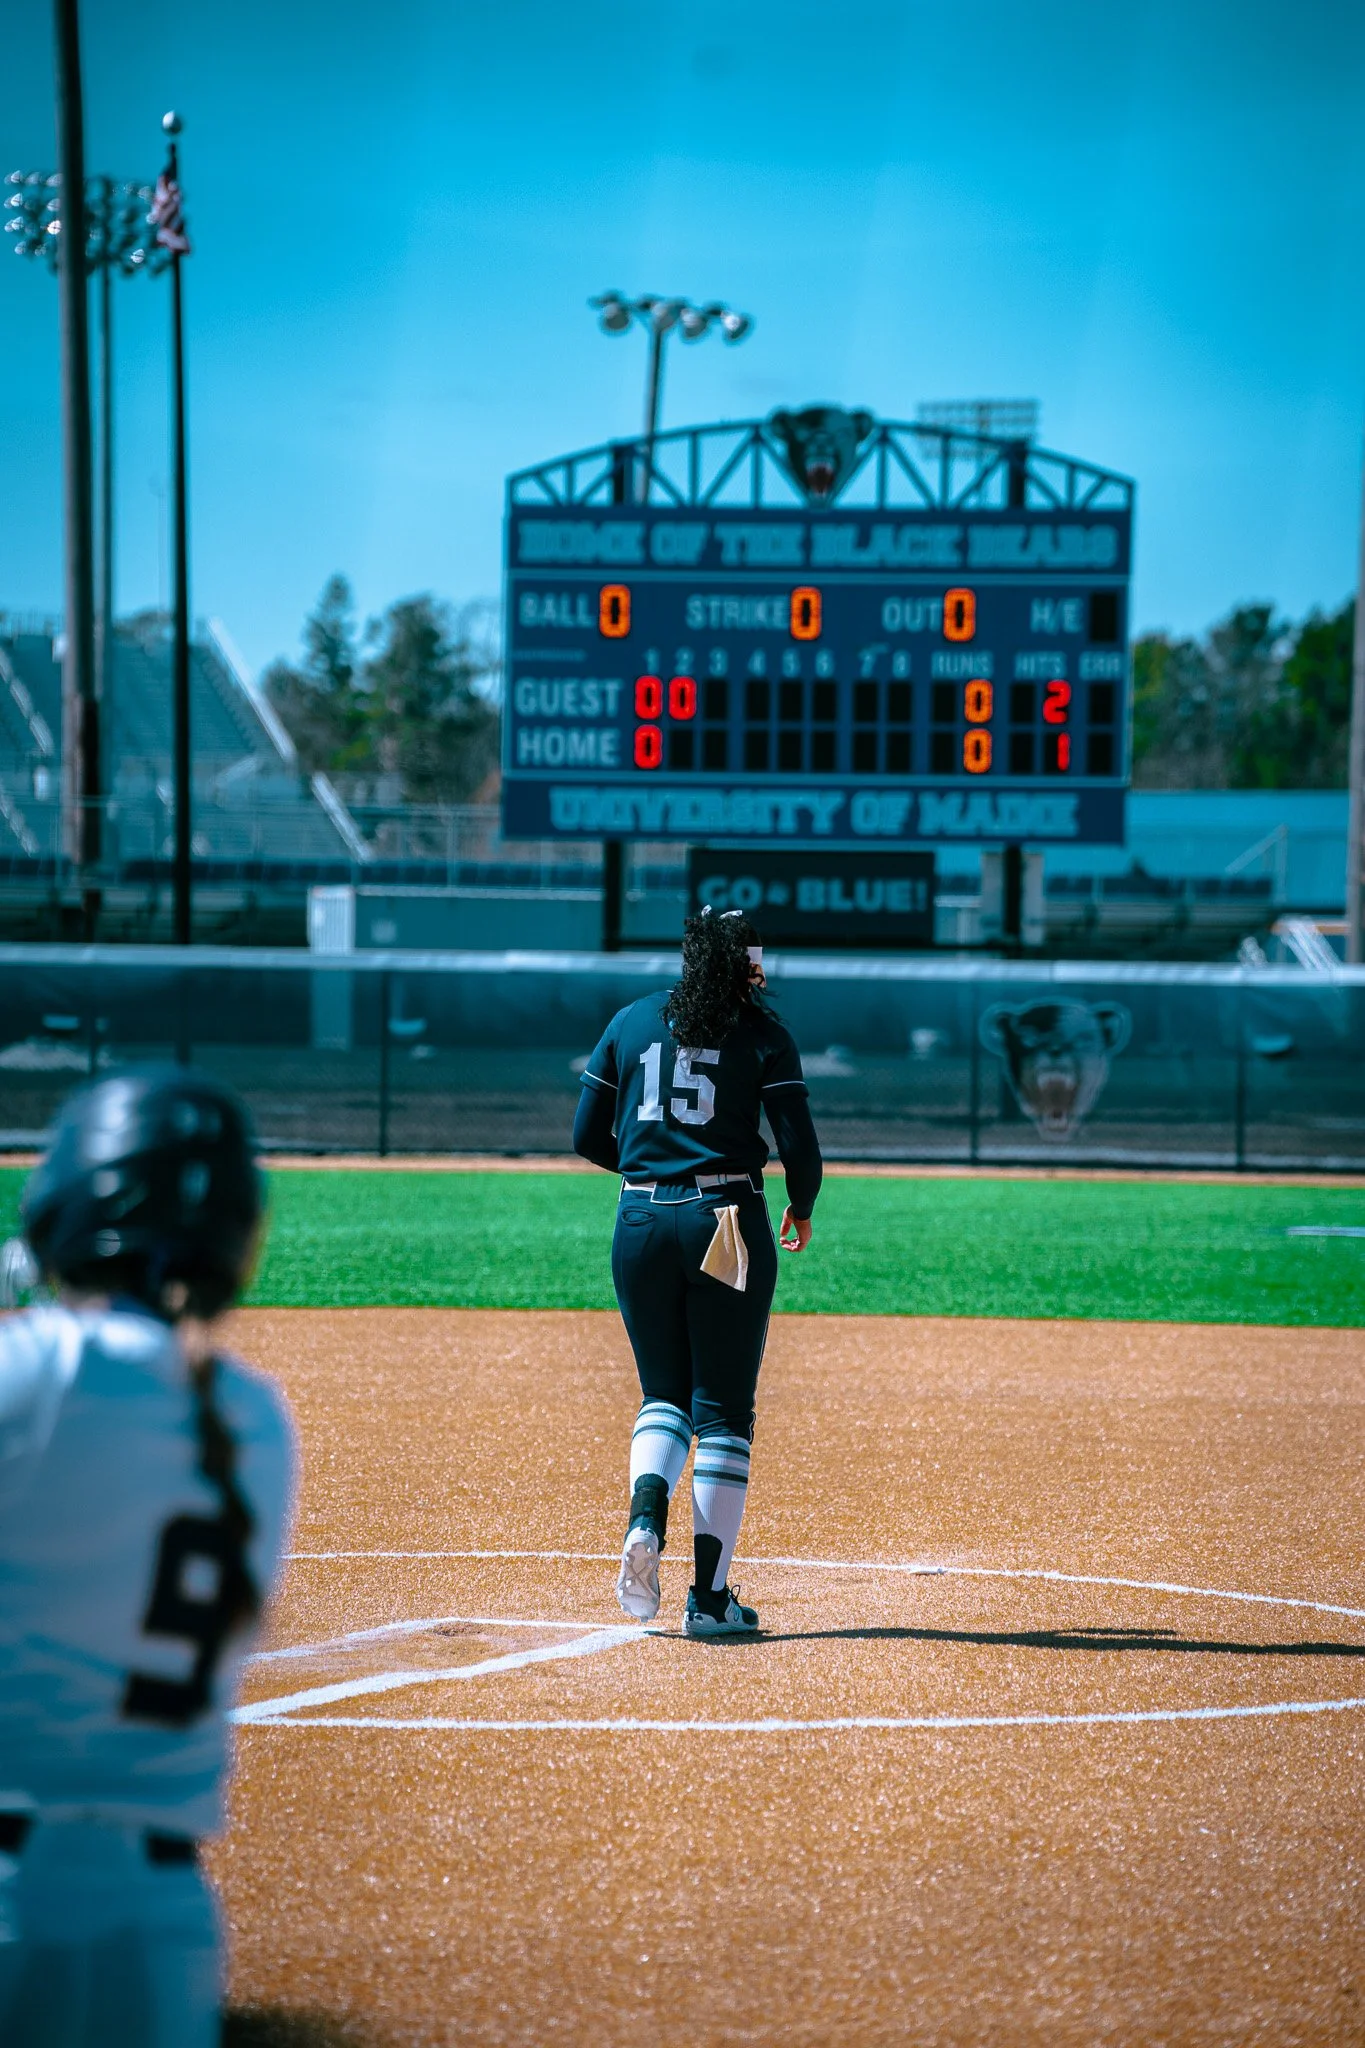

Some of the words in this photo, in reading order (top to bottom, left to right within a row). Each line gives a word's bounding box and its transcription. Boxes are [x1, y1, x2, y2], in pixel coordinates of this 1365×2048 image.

[651, 522, 710, 564] OF
[715, 523, 806, 566] THE
[811, 524, 963, 568] BLACK
[519, 592, 595, 627] BALL
[600, 584, 631, 638] 0
[686, 594, 791, 630] STRIKE
[791, 587, 822, 640] 0
[882, 597, 943, 633] OUT
[943, 588, 976, 641] 0
[1030, 597, 1083, 633] H/E
[643, 648, 660, 675] 1
[674, 647, 694, 676] 2
[709, 648, 728, 677] 3
[748, 648, 766, 677] 4
[782, 648, 800, 678] 5
[815, 648, 834, 679] 6
[514, 677, 622, 718] GUEST
[635, 675, 663, 719] 0
[668, 676, 697, 720] 0
[964, 679, 993, 723] 0
[1043, 679, 1071, 723] 2
[517, 726, 620, 767] HOME
[634, 724, 663, 769] 0
[963, 728, 993, 773] 0
[1057, 732, 1071, 771] 1
[549, 786, 844, 833] UNIVERSITY
[851, 791, 913, 836] OF
[917, 791, 1080, 838] MAINE
[698, 876, 763, 910] GO
[796, 877, 928, 913] BLUE!
[637, 1042, 720, 1126] 15
[118, 1510, 260, 1730] 9
